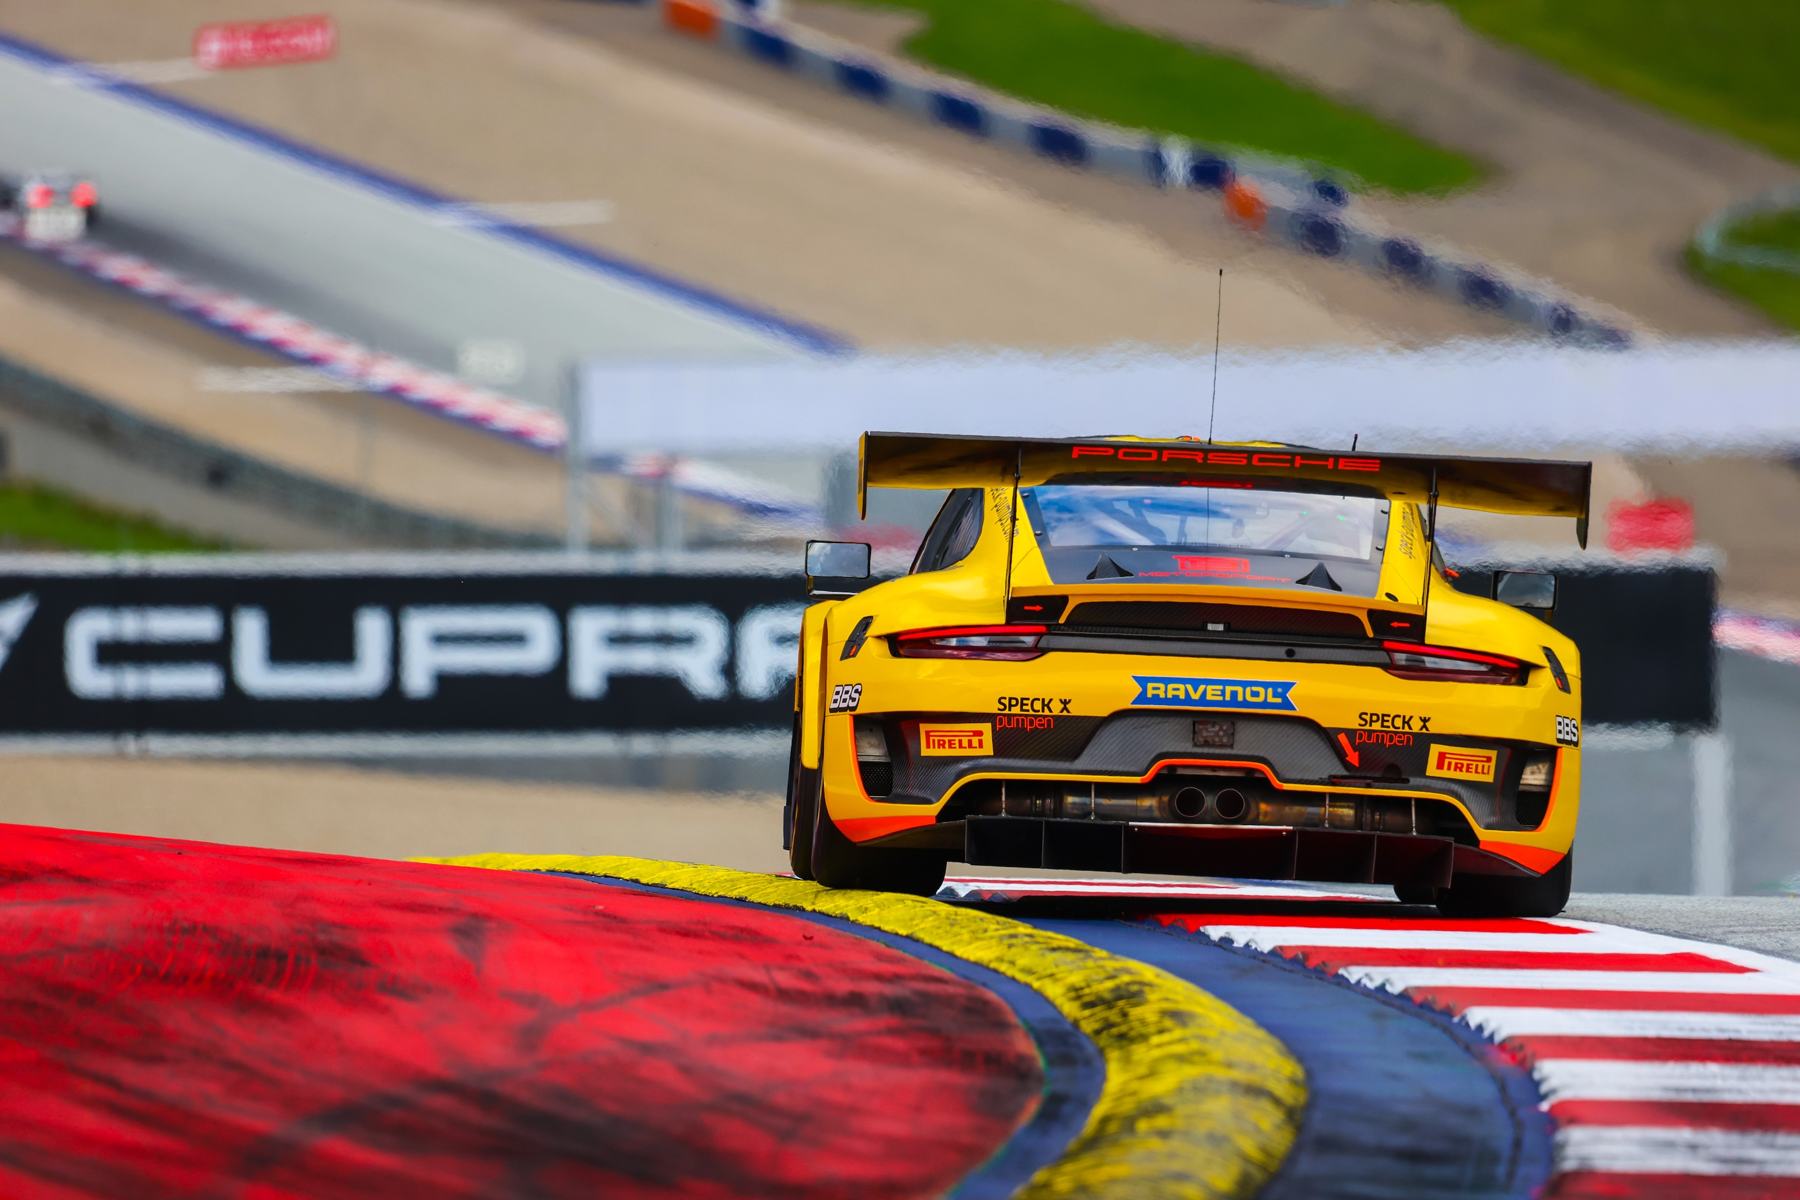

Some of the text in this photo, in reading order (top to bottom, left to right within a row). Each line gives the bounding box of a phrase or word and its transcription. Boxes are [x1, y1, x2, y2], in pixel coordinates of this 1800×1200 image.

[1071, 445, 1381, 472] PORSCHE
[829, 683, 862, 713] BBS
[997, 696, 1054, 713] SPECK
[996, 715, 1055, 732] pumpen
[1358, 711, 1414, 731] SPECK
[1556, 714, 1579, 747] BBS
[925, 730, 984, 749] PIRELLI
[1355, 729, 1414, 748] pumpen
[1436, 751, 1493, 775] PIRELLI
